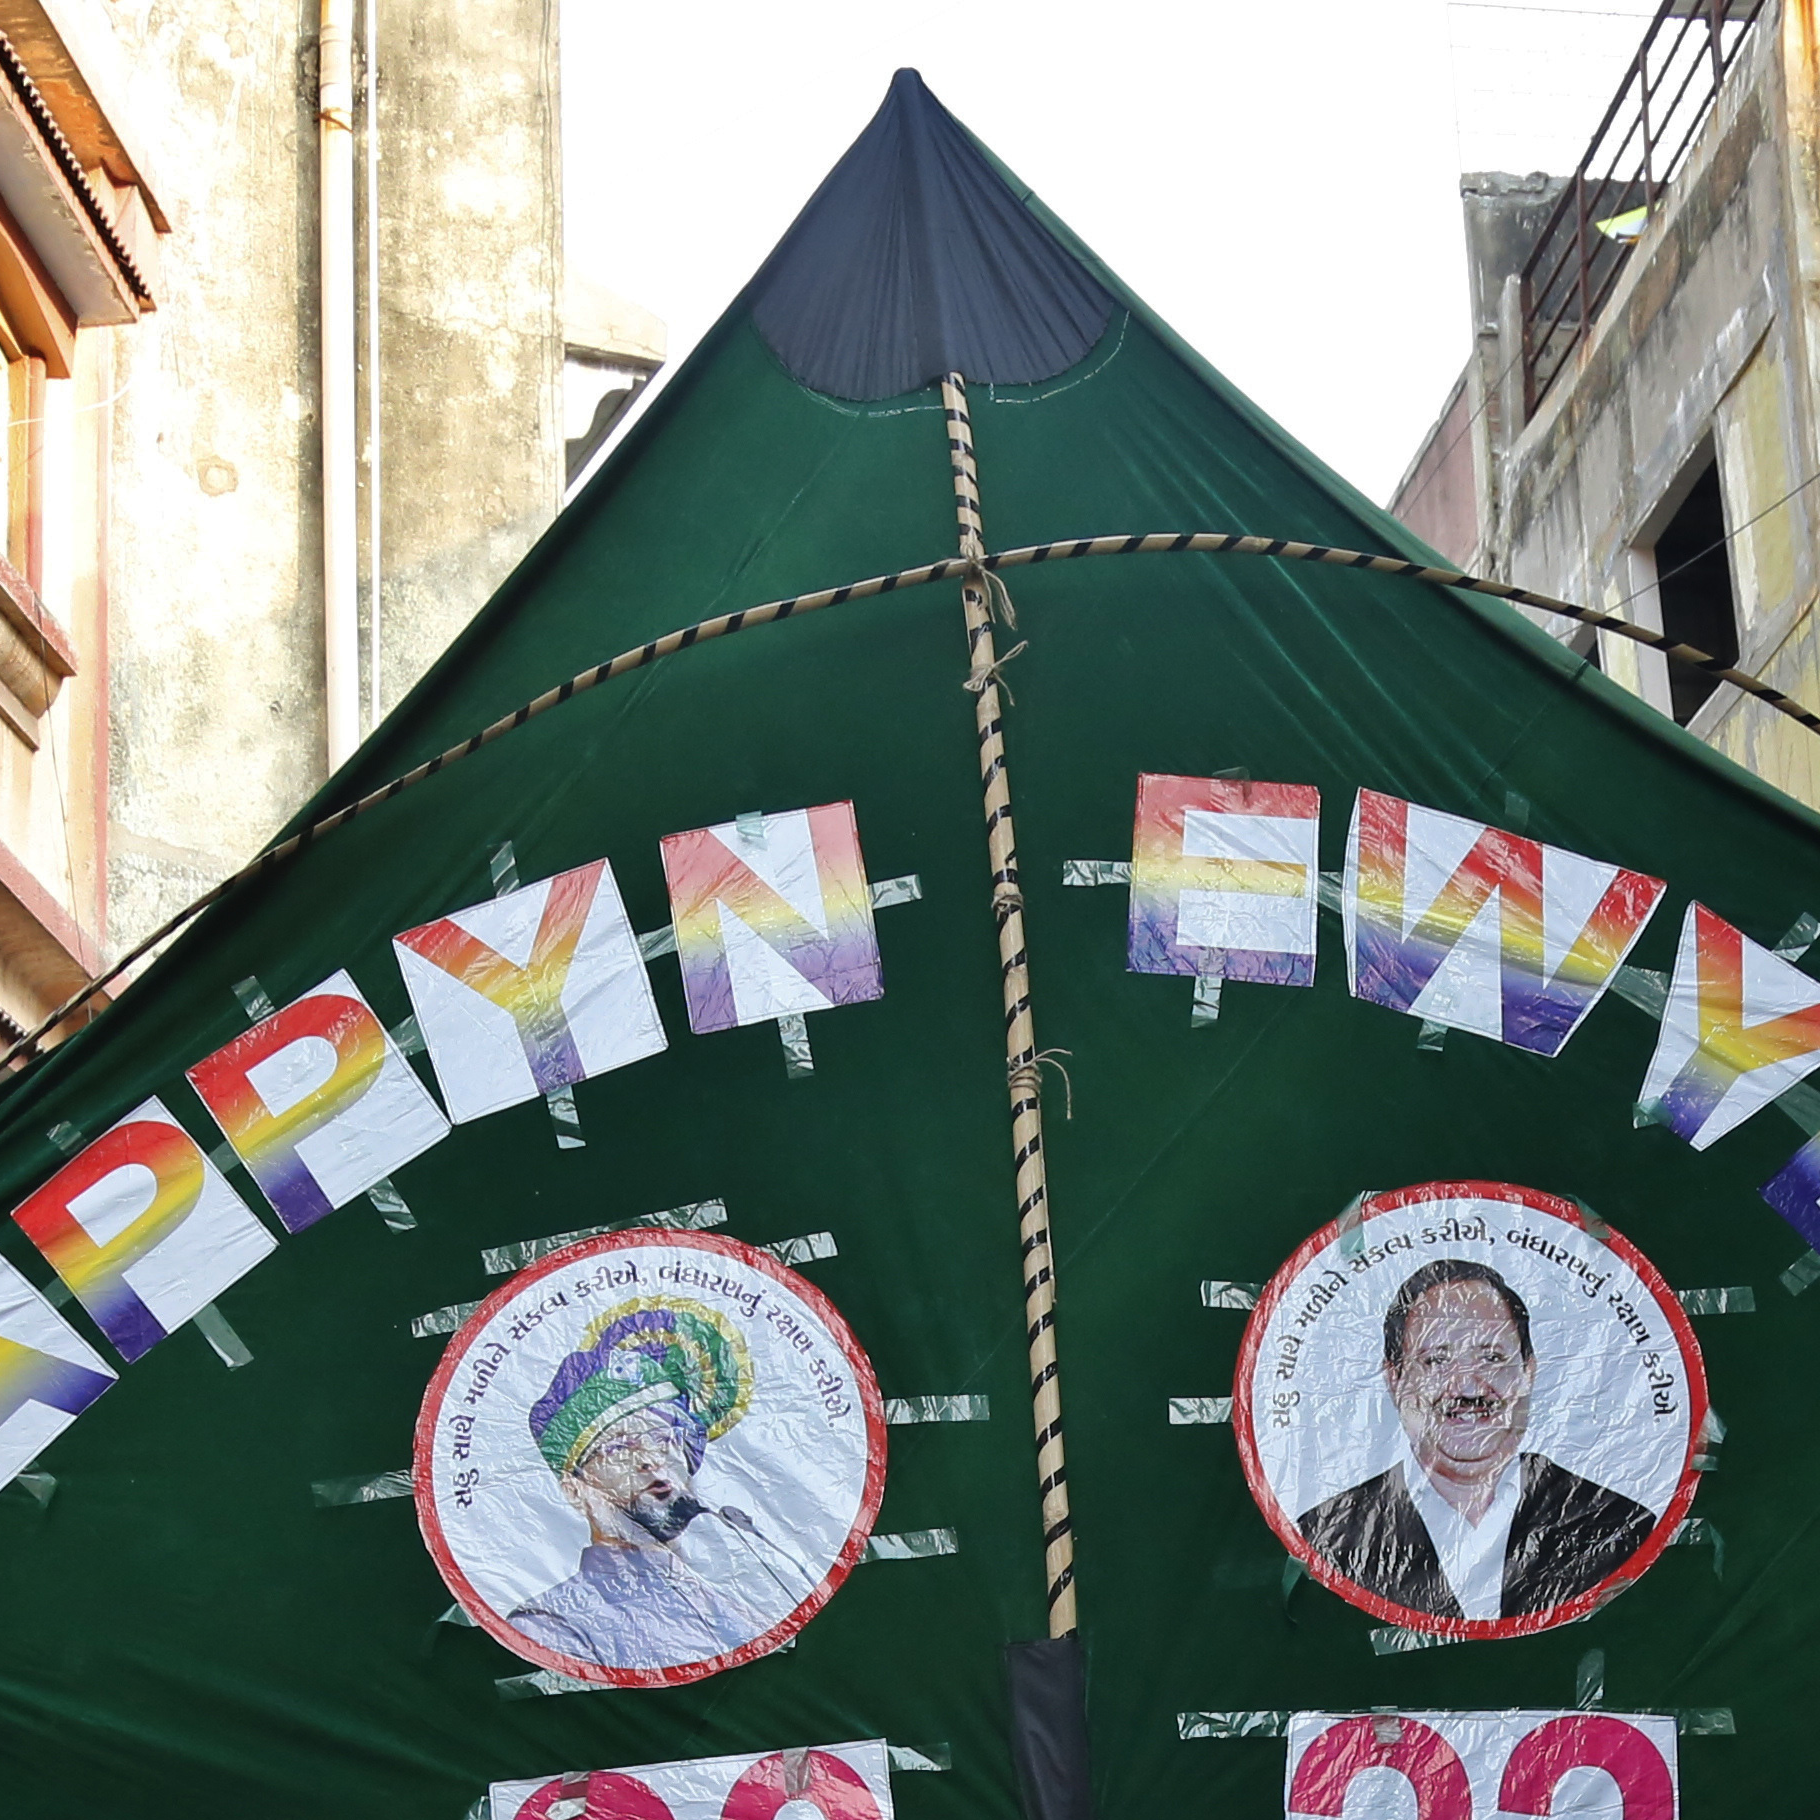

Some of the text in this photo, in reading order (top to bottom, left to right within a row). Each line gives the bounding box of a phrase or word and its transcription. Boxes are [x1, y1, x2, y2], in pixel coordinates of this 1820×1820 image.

[573, 1260, 649, 1301] કરીએ,
[1276, 1335, 1305, 1381] સાથે
[1294, 1269, 1349, 1329] મળીને
[1421, 1217, 1496, 1246] કરીએ,
[1607, 1290, 1651, 1345] રક્ષણ
[765, 1309, 815, 1356] રક્ષણ
[464, 1342, 510, 1408] મળીને
[452, 1410, 477, 1460] સાથે
